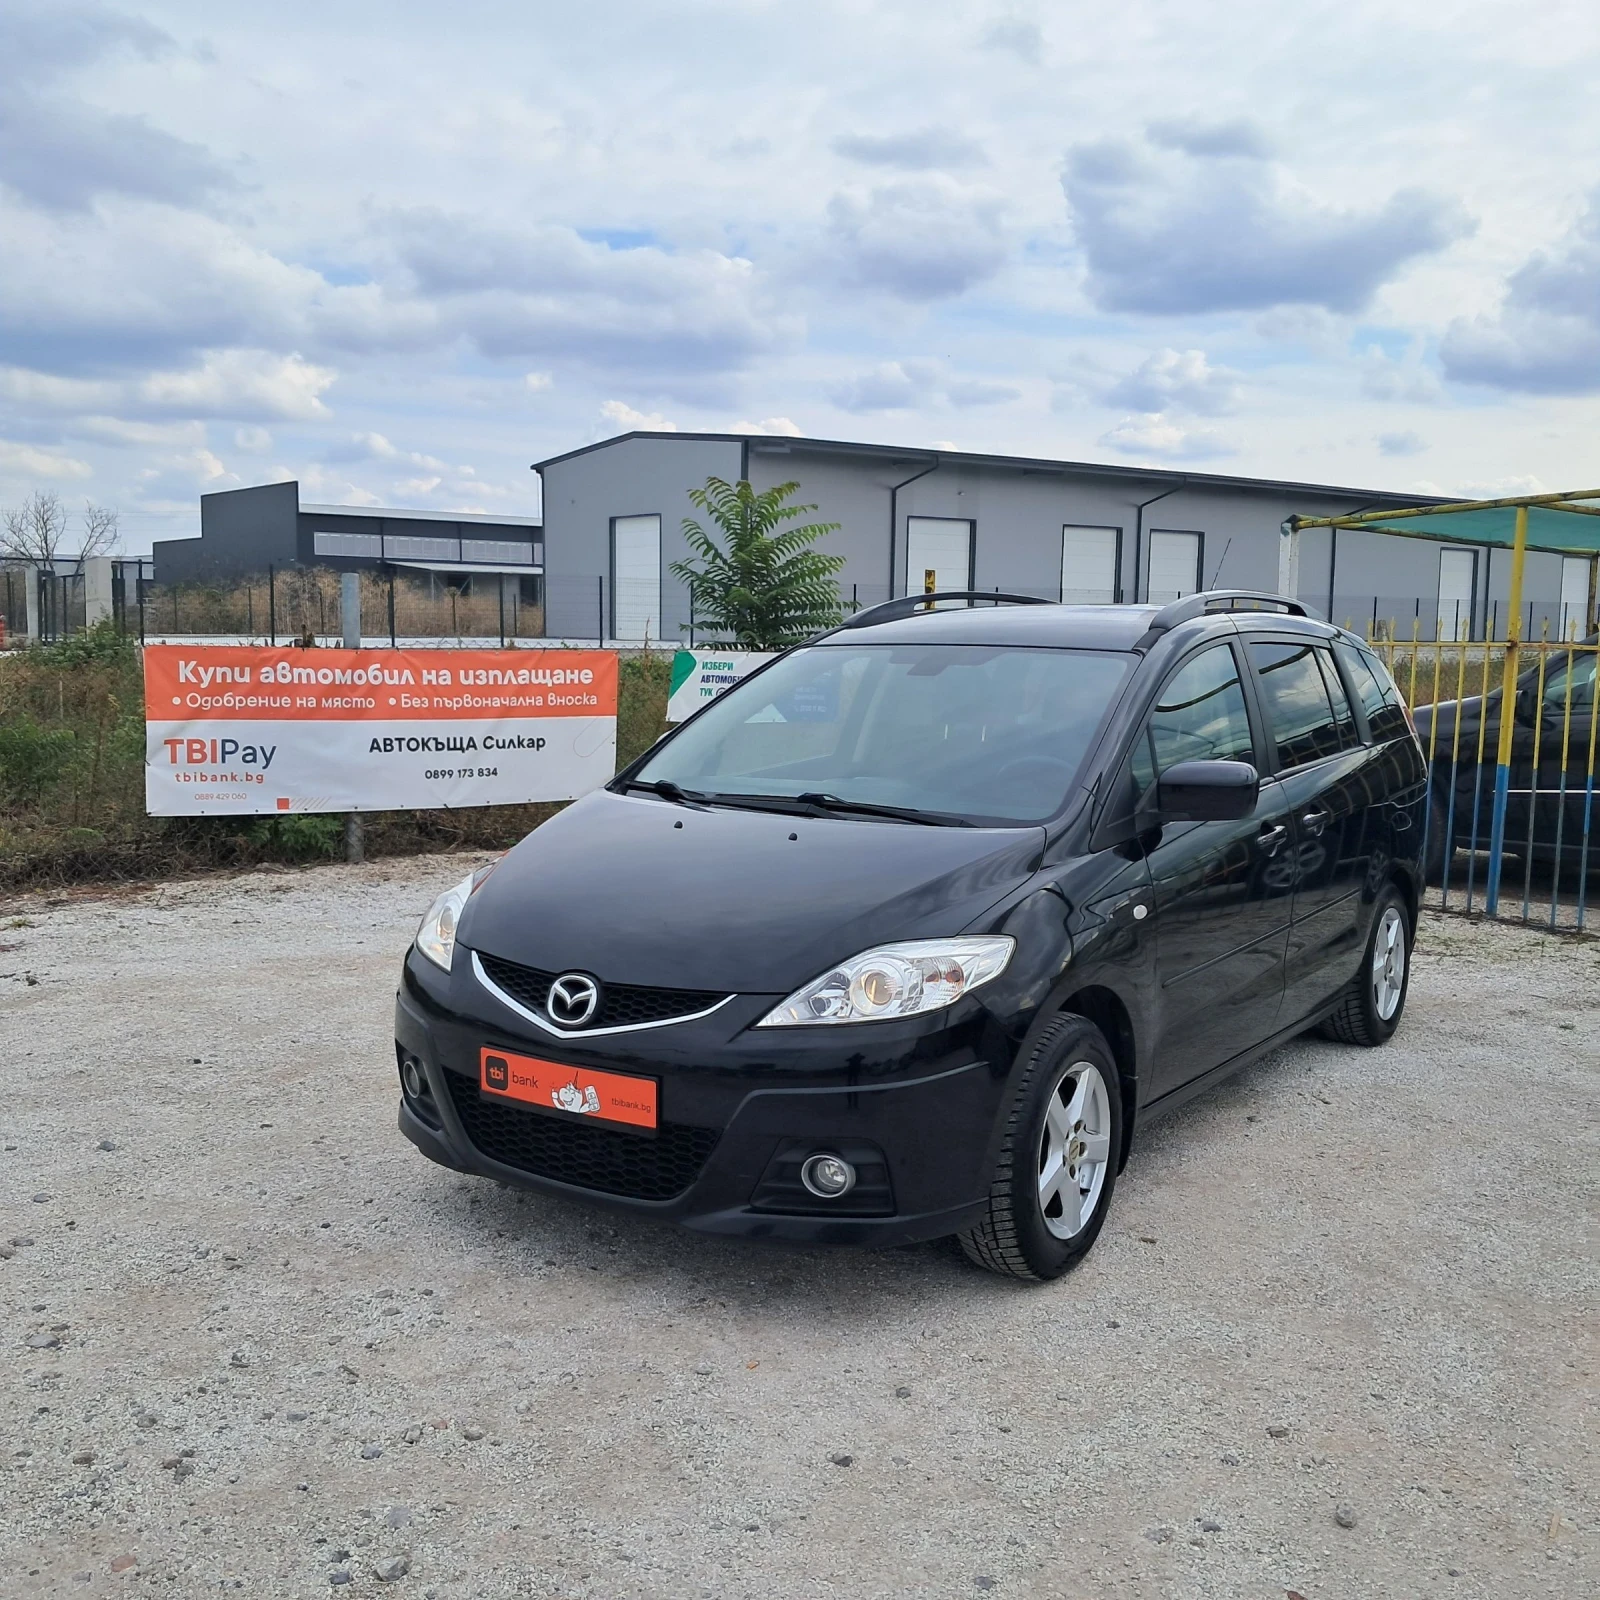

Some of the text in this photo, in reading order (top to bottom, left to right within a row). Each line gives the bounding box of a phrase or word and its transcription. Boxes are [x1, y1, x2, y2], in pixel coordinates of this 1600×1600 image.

[179, 661, 594, 688] Купи автомобил на изплащане
[702, 661, 734, 671] ИЗБЕРИ
[699, 687, 714, 697] ТУК
[186, 692, 375, 710] Одобрение на място
[401, 692, 598, 711] Без първоначална вноска
[369, 735, 546, 753] АВТОКЪЩА Силкар
[163, 739, 277, 770] TBIPay
[175, 772, 265, 784] tbibank.bg
[424, 767, 498, 780] 0899 173 834
[194, 793, 247, 801] 0889 429 060
[489, 1067, 539, 1089] tbi bank
[611, 1097, 651, 1114] tbibank.bg
